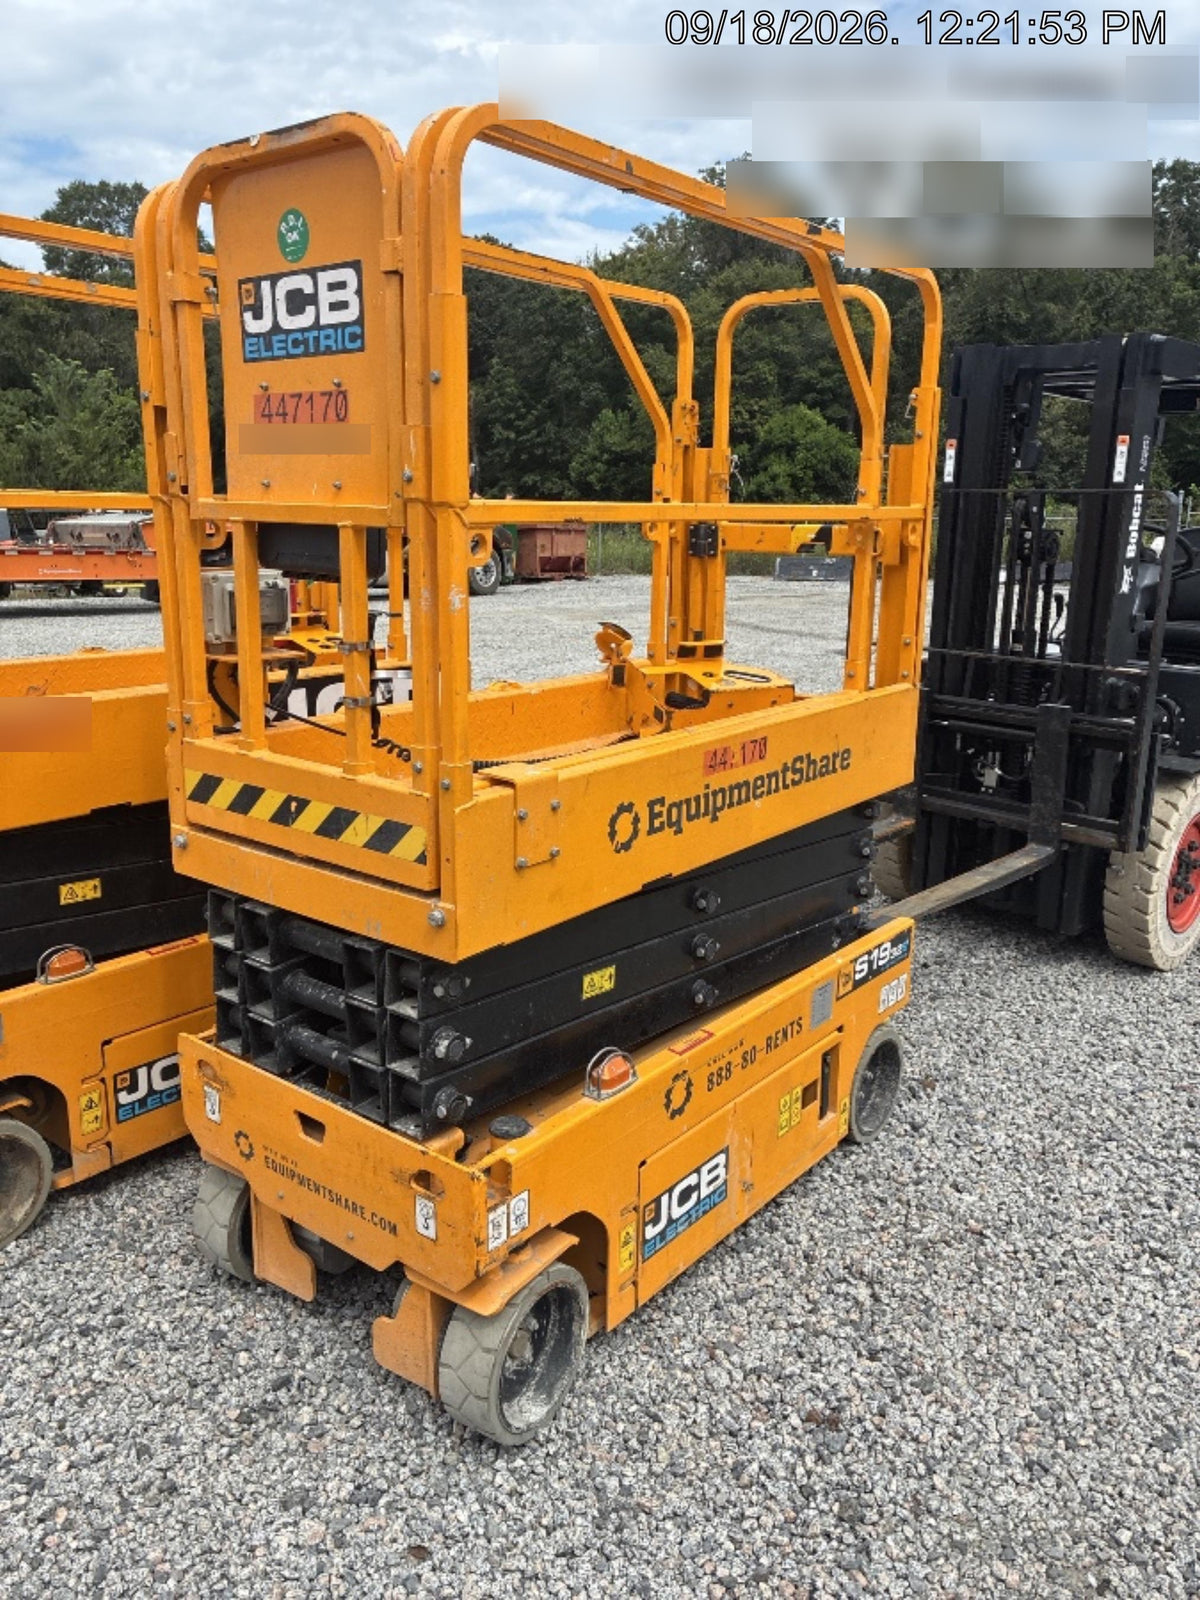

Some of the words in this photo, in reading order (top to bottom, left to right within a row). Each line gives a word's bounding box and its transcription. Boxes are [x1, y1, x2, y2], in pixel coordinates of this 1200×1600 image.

[243, 267, 360, 334] JCB
[244, 325, 362, 360] ELECTRIC
[260, 390, 349, 423] 447170
[1125, 482, 1145, 558] Bobcat
[708, 736, 767, 772] 44170
[646, 747, 852, 836] EquipmentShare
[117, 1054, 181, 1105] JC
[706, 1016, 803, 1093] 888-80-RENTS
[118, 1086, 179, 1121] ELEC
[264, 1155, 399, 1237] EQUIPMENTSHARE.COM
[644, 1182, 727, 1260] ELECTRIC
[645, 1152, 727, 1240] JCB
